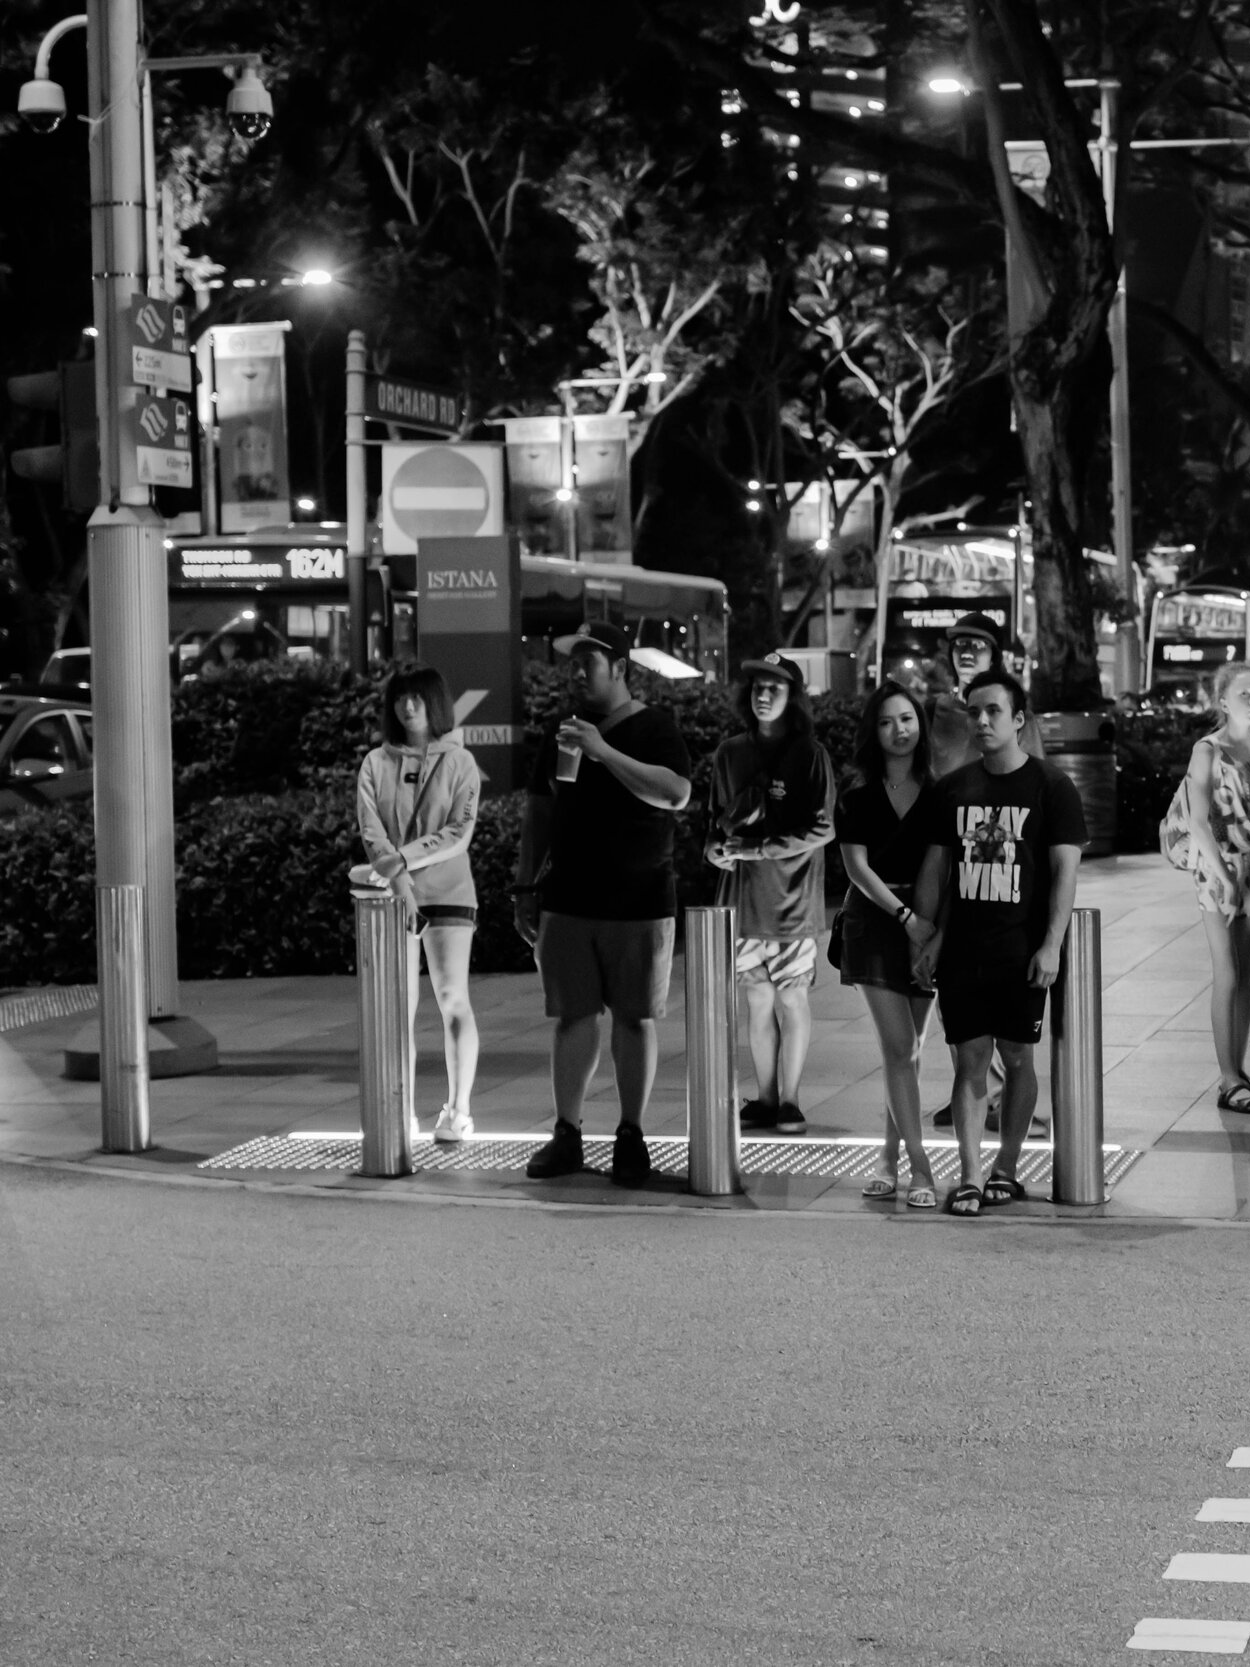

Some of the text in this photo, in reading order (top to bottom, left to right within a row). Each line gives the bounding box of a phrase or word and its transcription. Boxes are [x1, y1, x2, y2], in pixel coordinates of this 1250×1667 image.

[378, 381, 455, 425] ORCHARD RD
[286, 549, 344, 578] 162M
[427, 569, 498, 589] ISTANA
[959, 861, 1021, 903] WIN!
